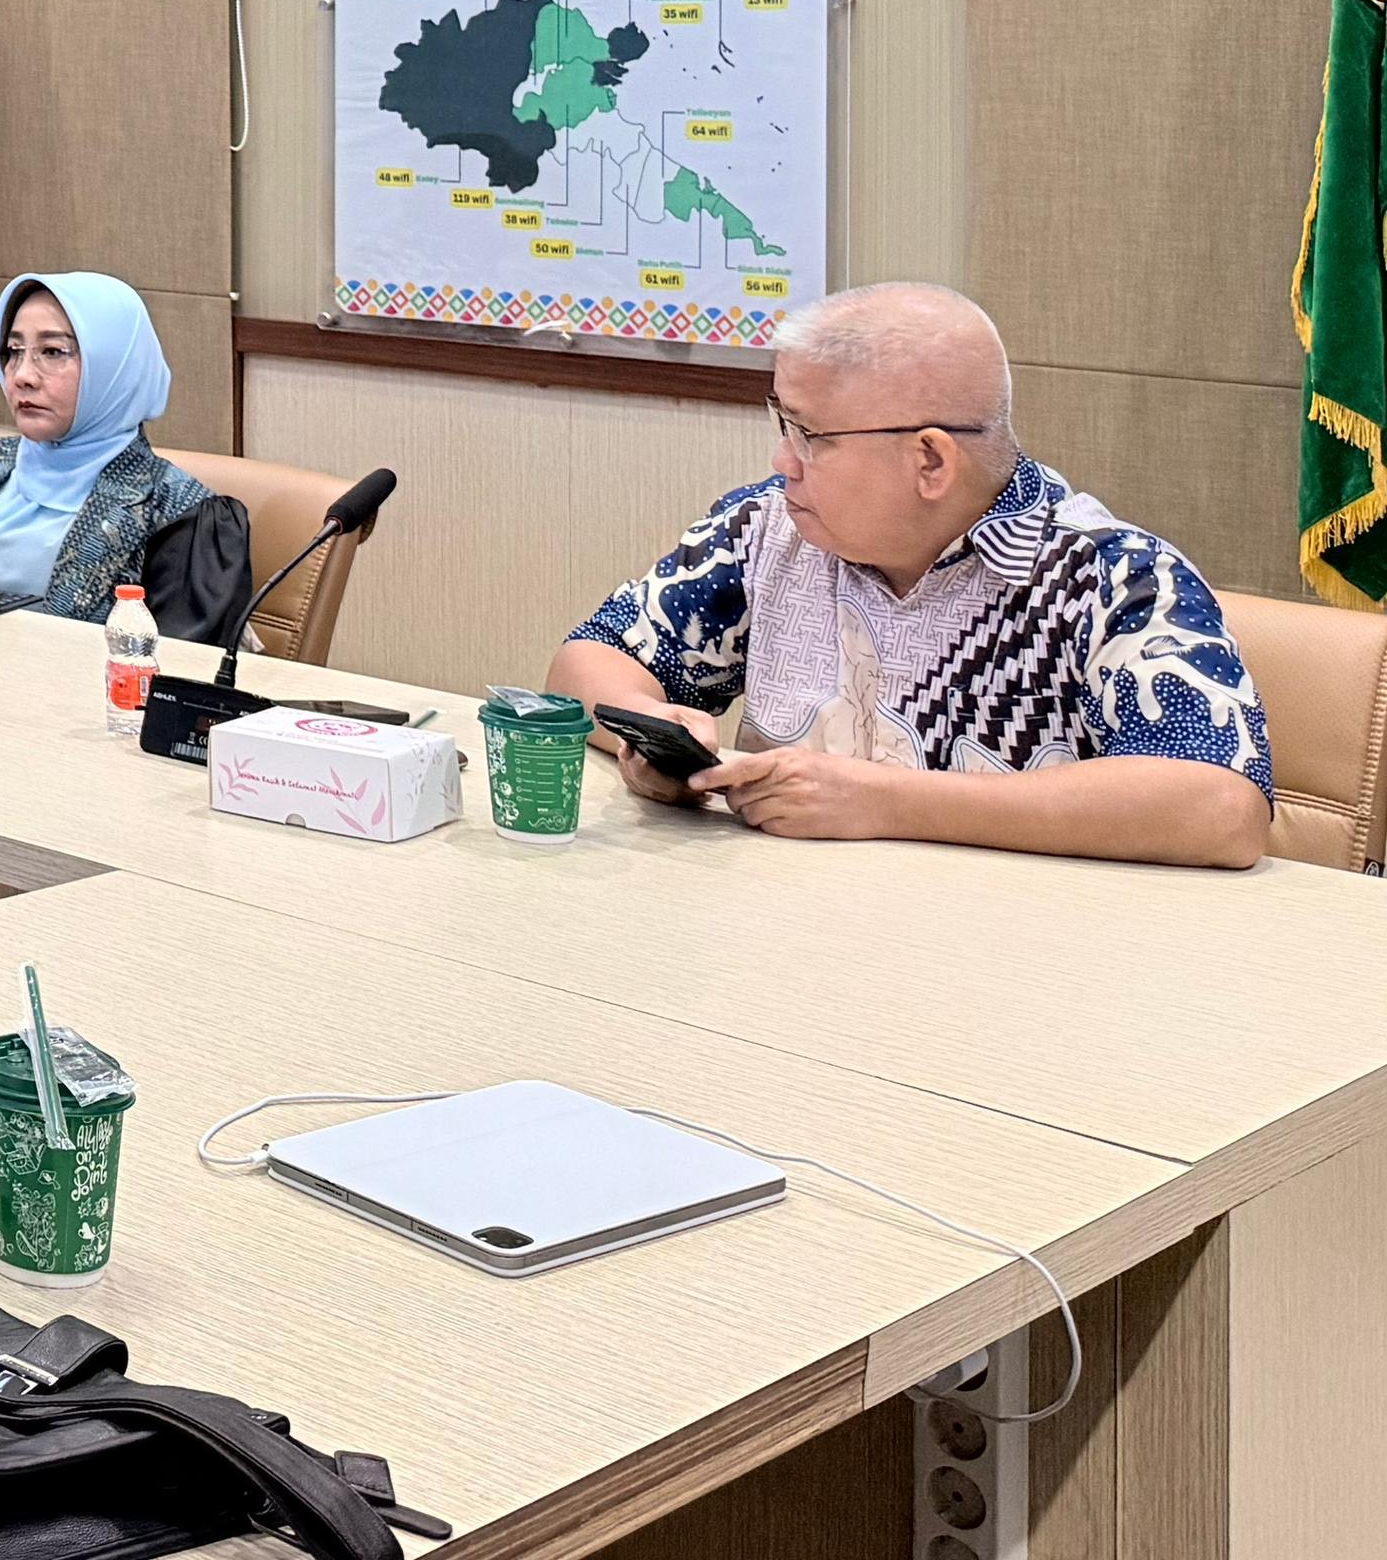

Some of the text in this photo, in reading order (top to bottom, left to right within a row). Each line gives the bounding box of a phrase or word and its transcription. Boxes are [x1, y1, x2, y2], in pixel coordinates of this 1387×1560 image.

[663, 8, 698, 19] 35 wifi
[692, 125, 728, 137] 64 wifi
[392, 172, 410, 183] wifi
[471, 193, 490, 205] wifi
[505, 214, 537, 226] 38 wifi
[535, 243, 570, 255] 50 wifi
[645, 273, 680, 286] 61 wifi
[746, 281, 783, 294] 56 wifi
